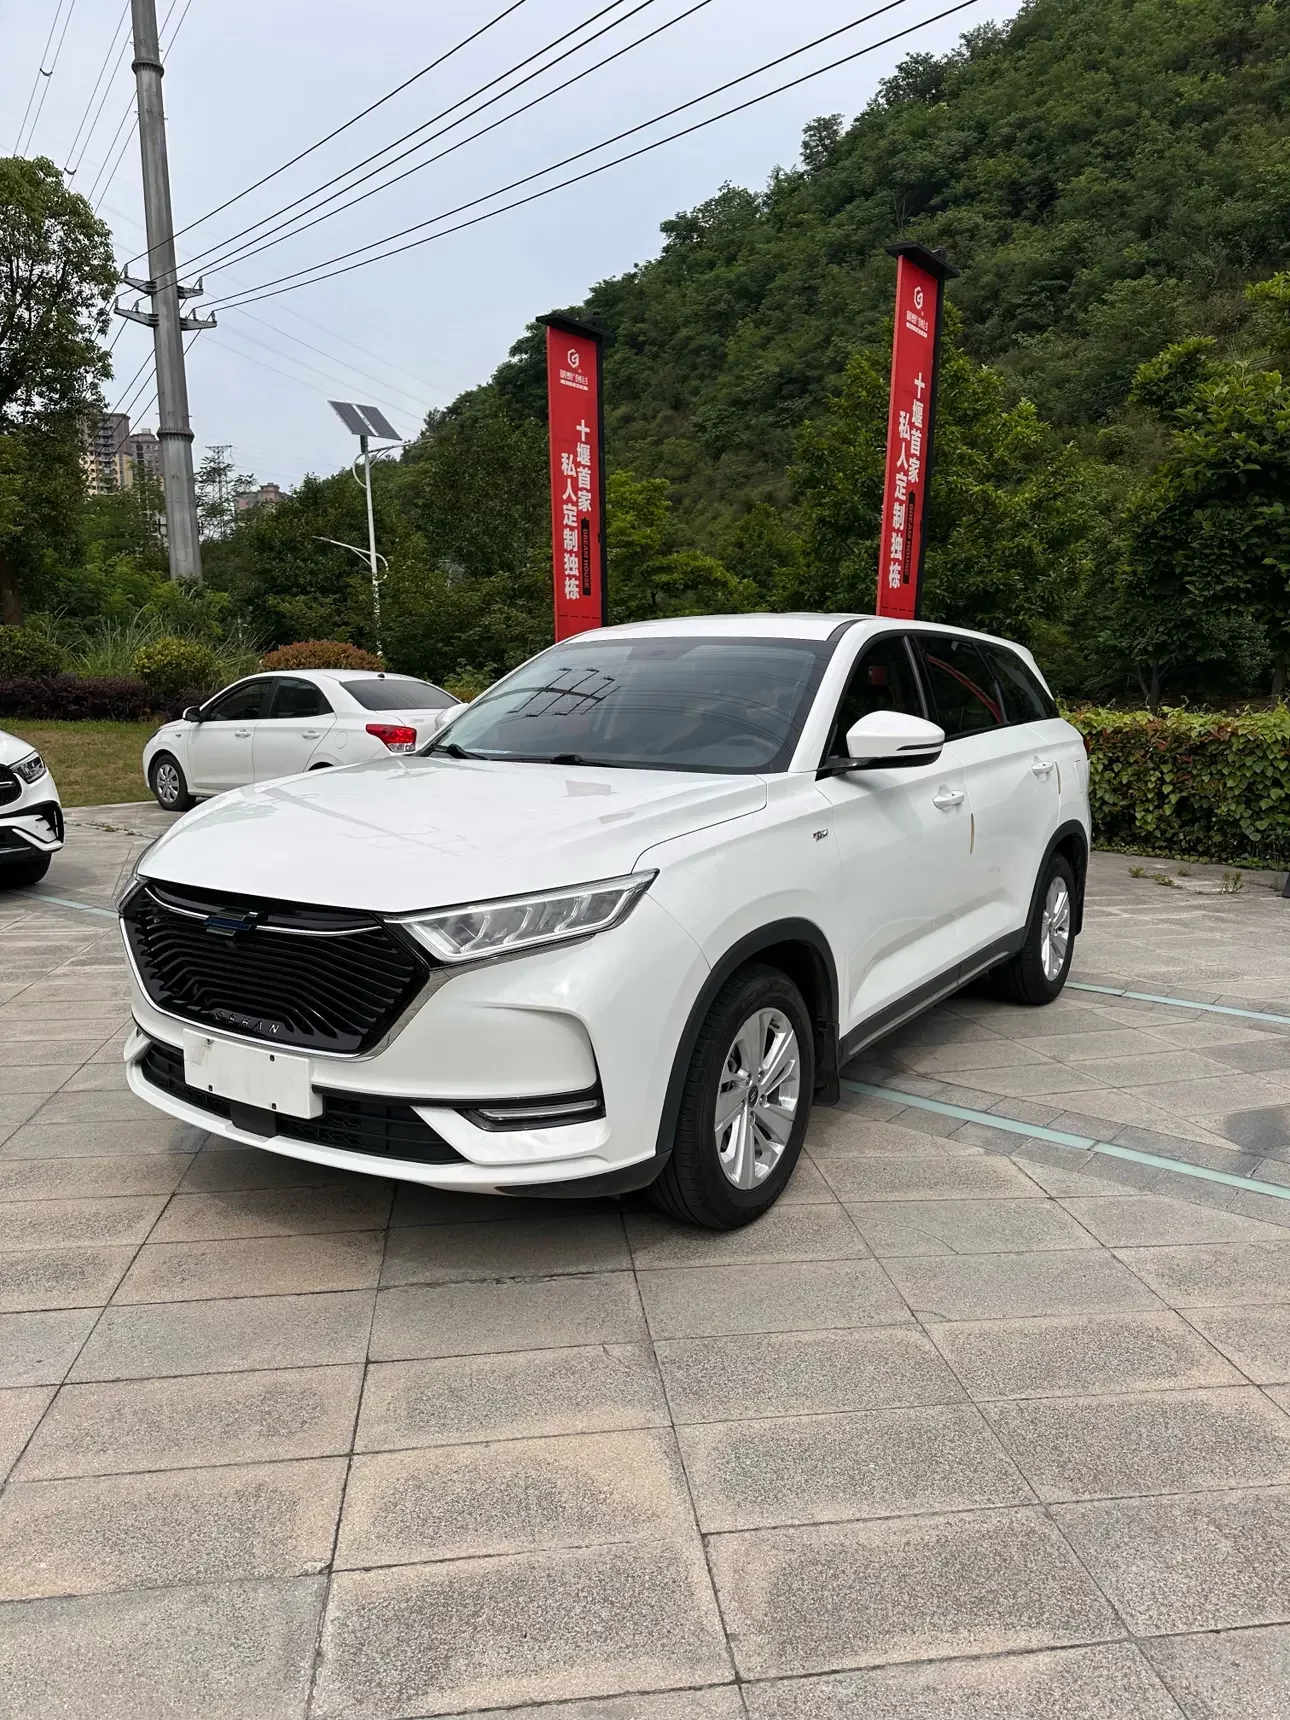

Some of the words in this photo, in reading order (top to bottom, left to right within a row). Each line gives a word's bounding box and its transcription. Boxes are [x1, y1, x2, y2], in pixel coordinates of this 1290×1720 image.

[576, 419, 592, 512] 十堰首家
[908, 372, 926, 483] 十堰首家
[561, 452, 580, 600] 私人定制独栋
[889, 410, 910, 589] 私人定制独栋
